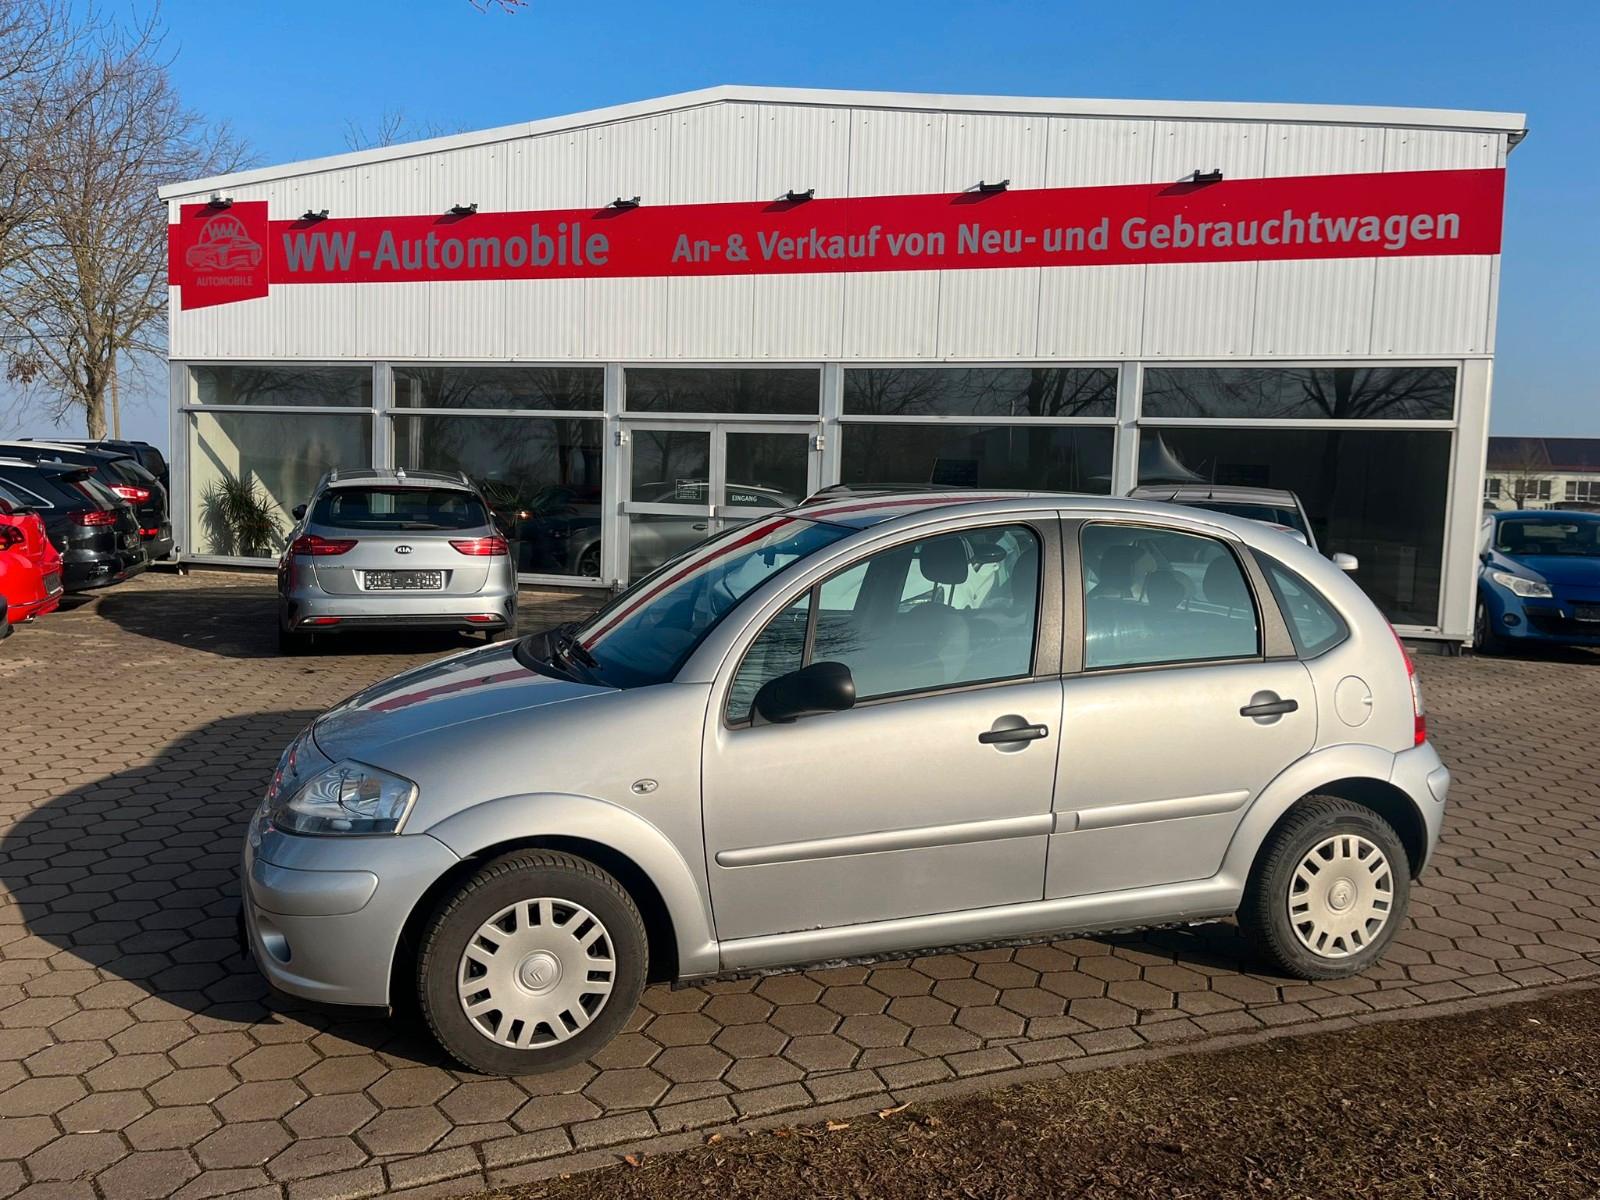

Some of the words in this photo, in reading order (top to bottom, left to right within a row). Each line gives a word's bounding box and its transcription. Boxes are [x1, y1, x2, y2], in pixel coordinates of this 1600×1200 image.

[283, 223, 609, 272] WW-Automobile
[671, 234, 721, 263] An-
[725, 234, 750, 262] &
[757, 225, 882, 261] Verkauf
[886, 231, 945, 257] von
[1121, 209, 1460, 250] Gebrauchtwagen
[196, 275, 253, 287] AUTOMOBILE
